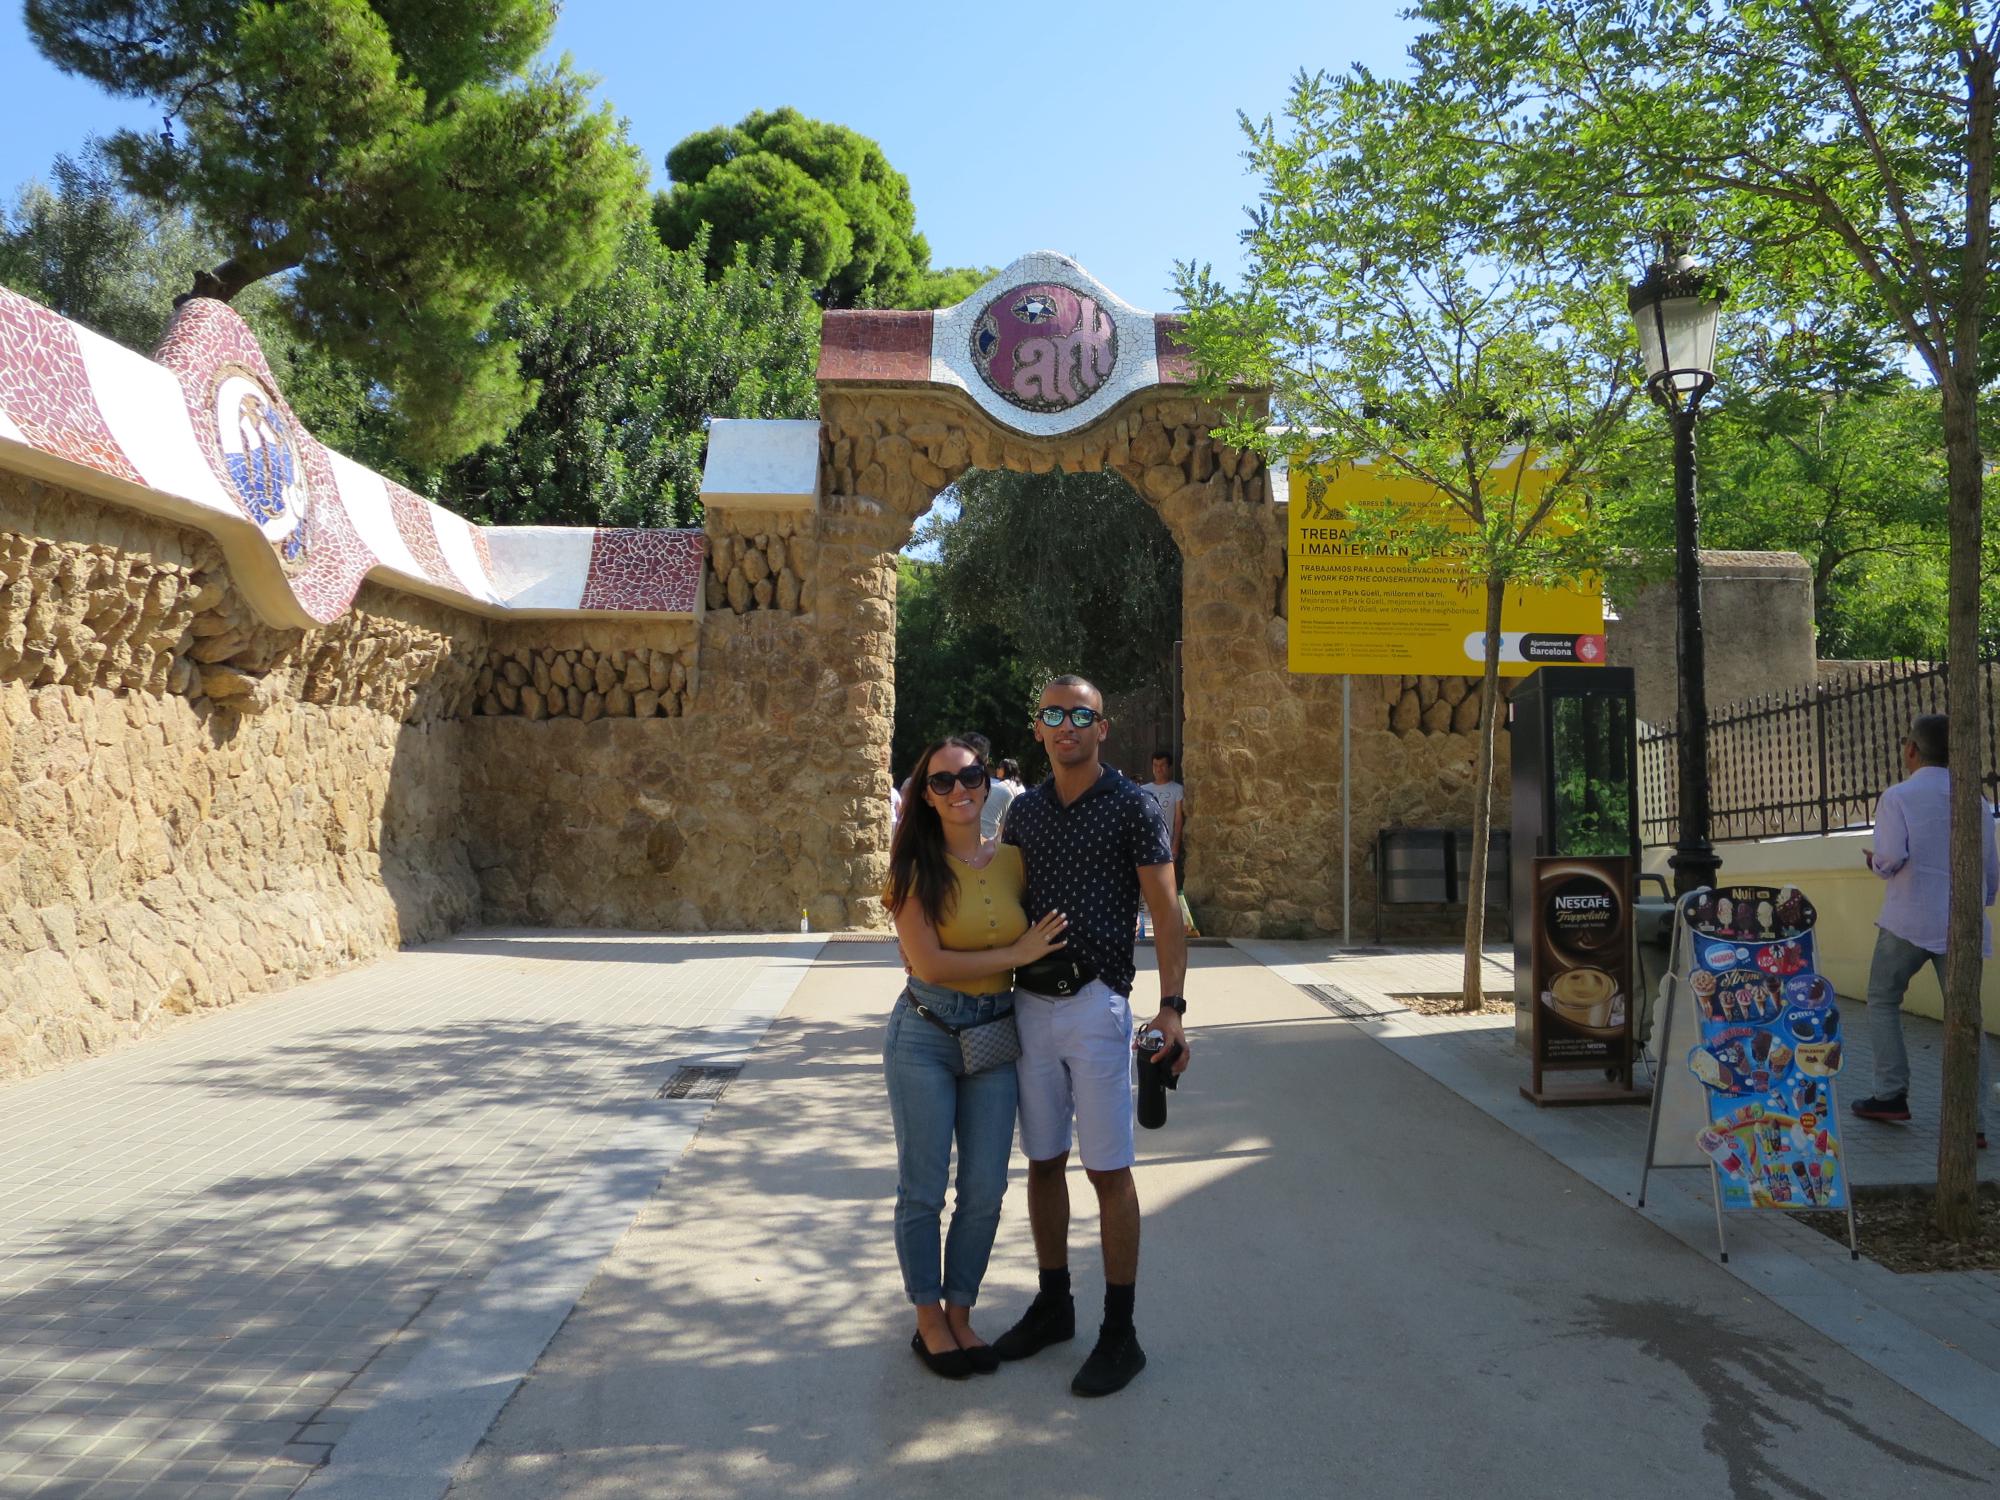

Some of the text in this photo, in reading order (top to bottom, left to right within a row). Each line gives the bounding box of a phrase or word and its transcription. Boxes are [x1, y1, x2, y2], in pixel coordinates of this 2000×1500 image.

[1300, 565, 1352, 573] TRABAJAMOS
[1353, 565, 1374, 573] PARA
[1372, 576, 1430, 584] CONSERVATION
[1530, 640, 1564, 648] Ajuntament
[1530, 647, 1572, 656] Barcelona
